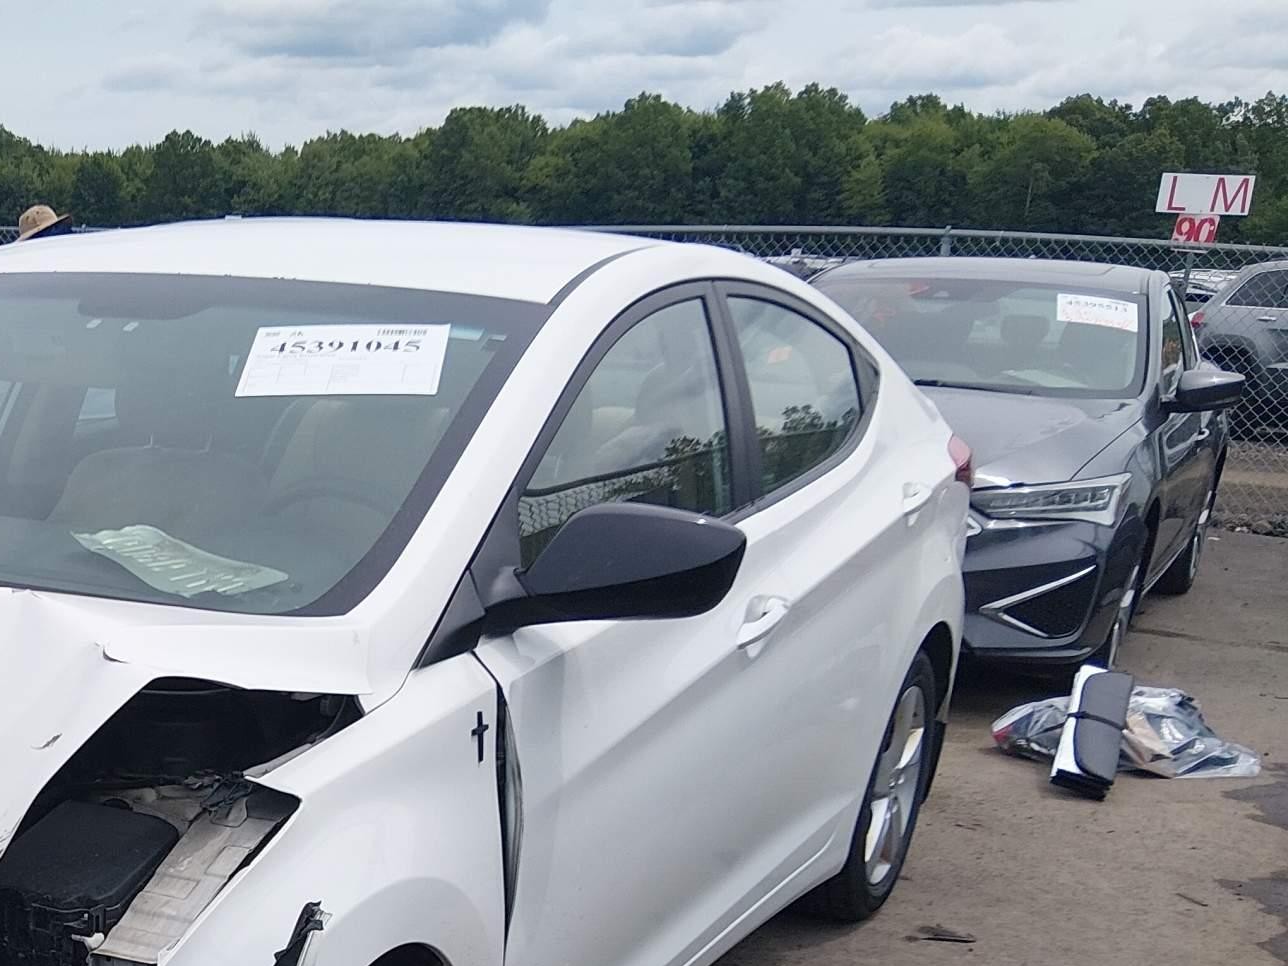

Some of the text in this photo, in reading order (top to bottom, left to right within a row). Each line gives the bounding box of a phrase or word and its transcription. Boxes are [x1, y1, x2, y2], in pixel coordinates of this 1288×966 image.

[1167, 175, 1250, 214] L M
[270, 339, 422, 354] 45391045
